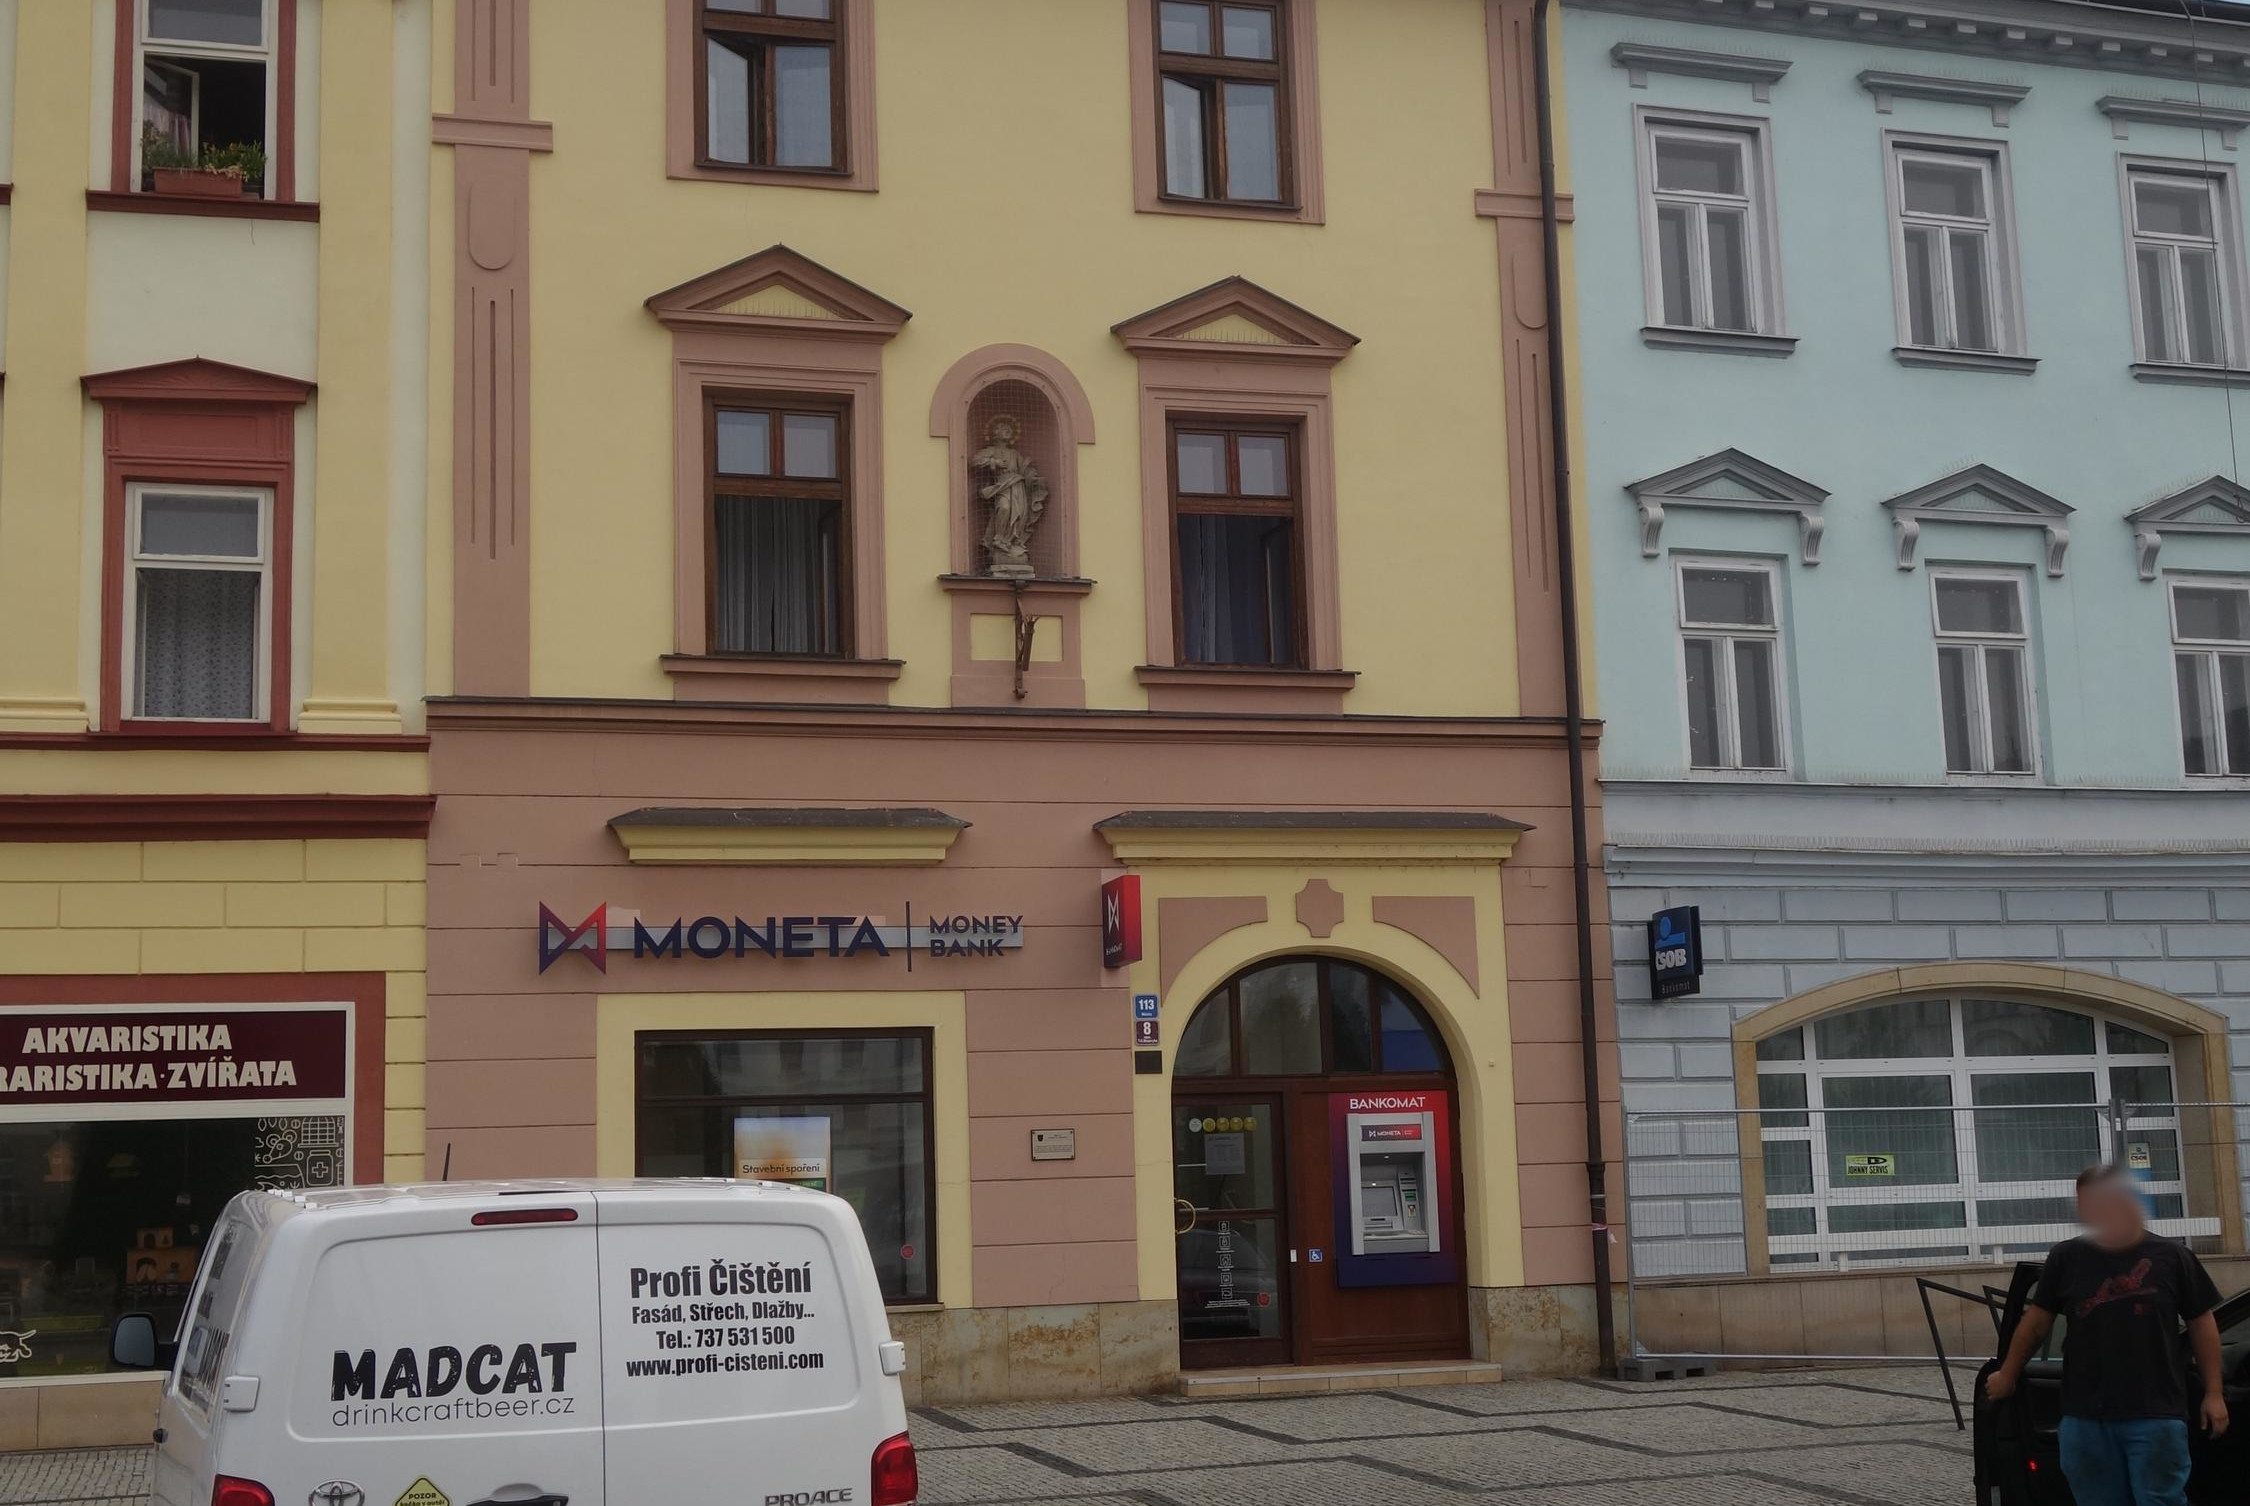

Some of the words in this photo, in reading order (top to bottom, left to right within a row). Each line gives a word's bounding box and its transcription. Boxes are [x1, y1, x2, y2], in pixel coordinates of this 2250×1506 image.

[929, 914, 1024, 934] MONEY
[633, 915, 891, 959] MONETA
[929, 939, 1004, 958] BANK
[1138, 999, 1155, 1010] 113
[22, 1024, 233, 1054] AKVARISTIKA
[1143, 1021, 1151, 1035] 8
[167, 1055, 297, 1089] ZVÍŘATA
[1350, 1096, 1426, 1110] BANKOMAT
[742, 1163, 785, 1174] Stavební
[786, 1163, 820, 1176] spoření
[630, 1265, 702, 1299] Profi
[709, 1258, 812, 1296] Čištění
[632, 1304, 686, 1325] Fasád,
[690, 1301, 749, 1322] Střech,
[752, 1300, 815, 1320] Dlažby...
[656, 1330, 692, 1350] Tel.:
[695, 1328, 724, 1348] 737
[728, 1327, 758, 1347] 531
[762, 1325, 795, 1345] 500
[331, 1341, 577, 1402] MADCAT
[626, 1351, 824, 1378] www.profi-cisteni.com
[332, 1397, 575, 1427] drinkcraftbeer.cz
[408, 1492, 437, 1500] POZOR
[765, 1488, 853, 1506] PROACE
